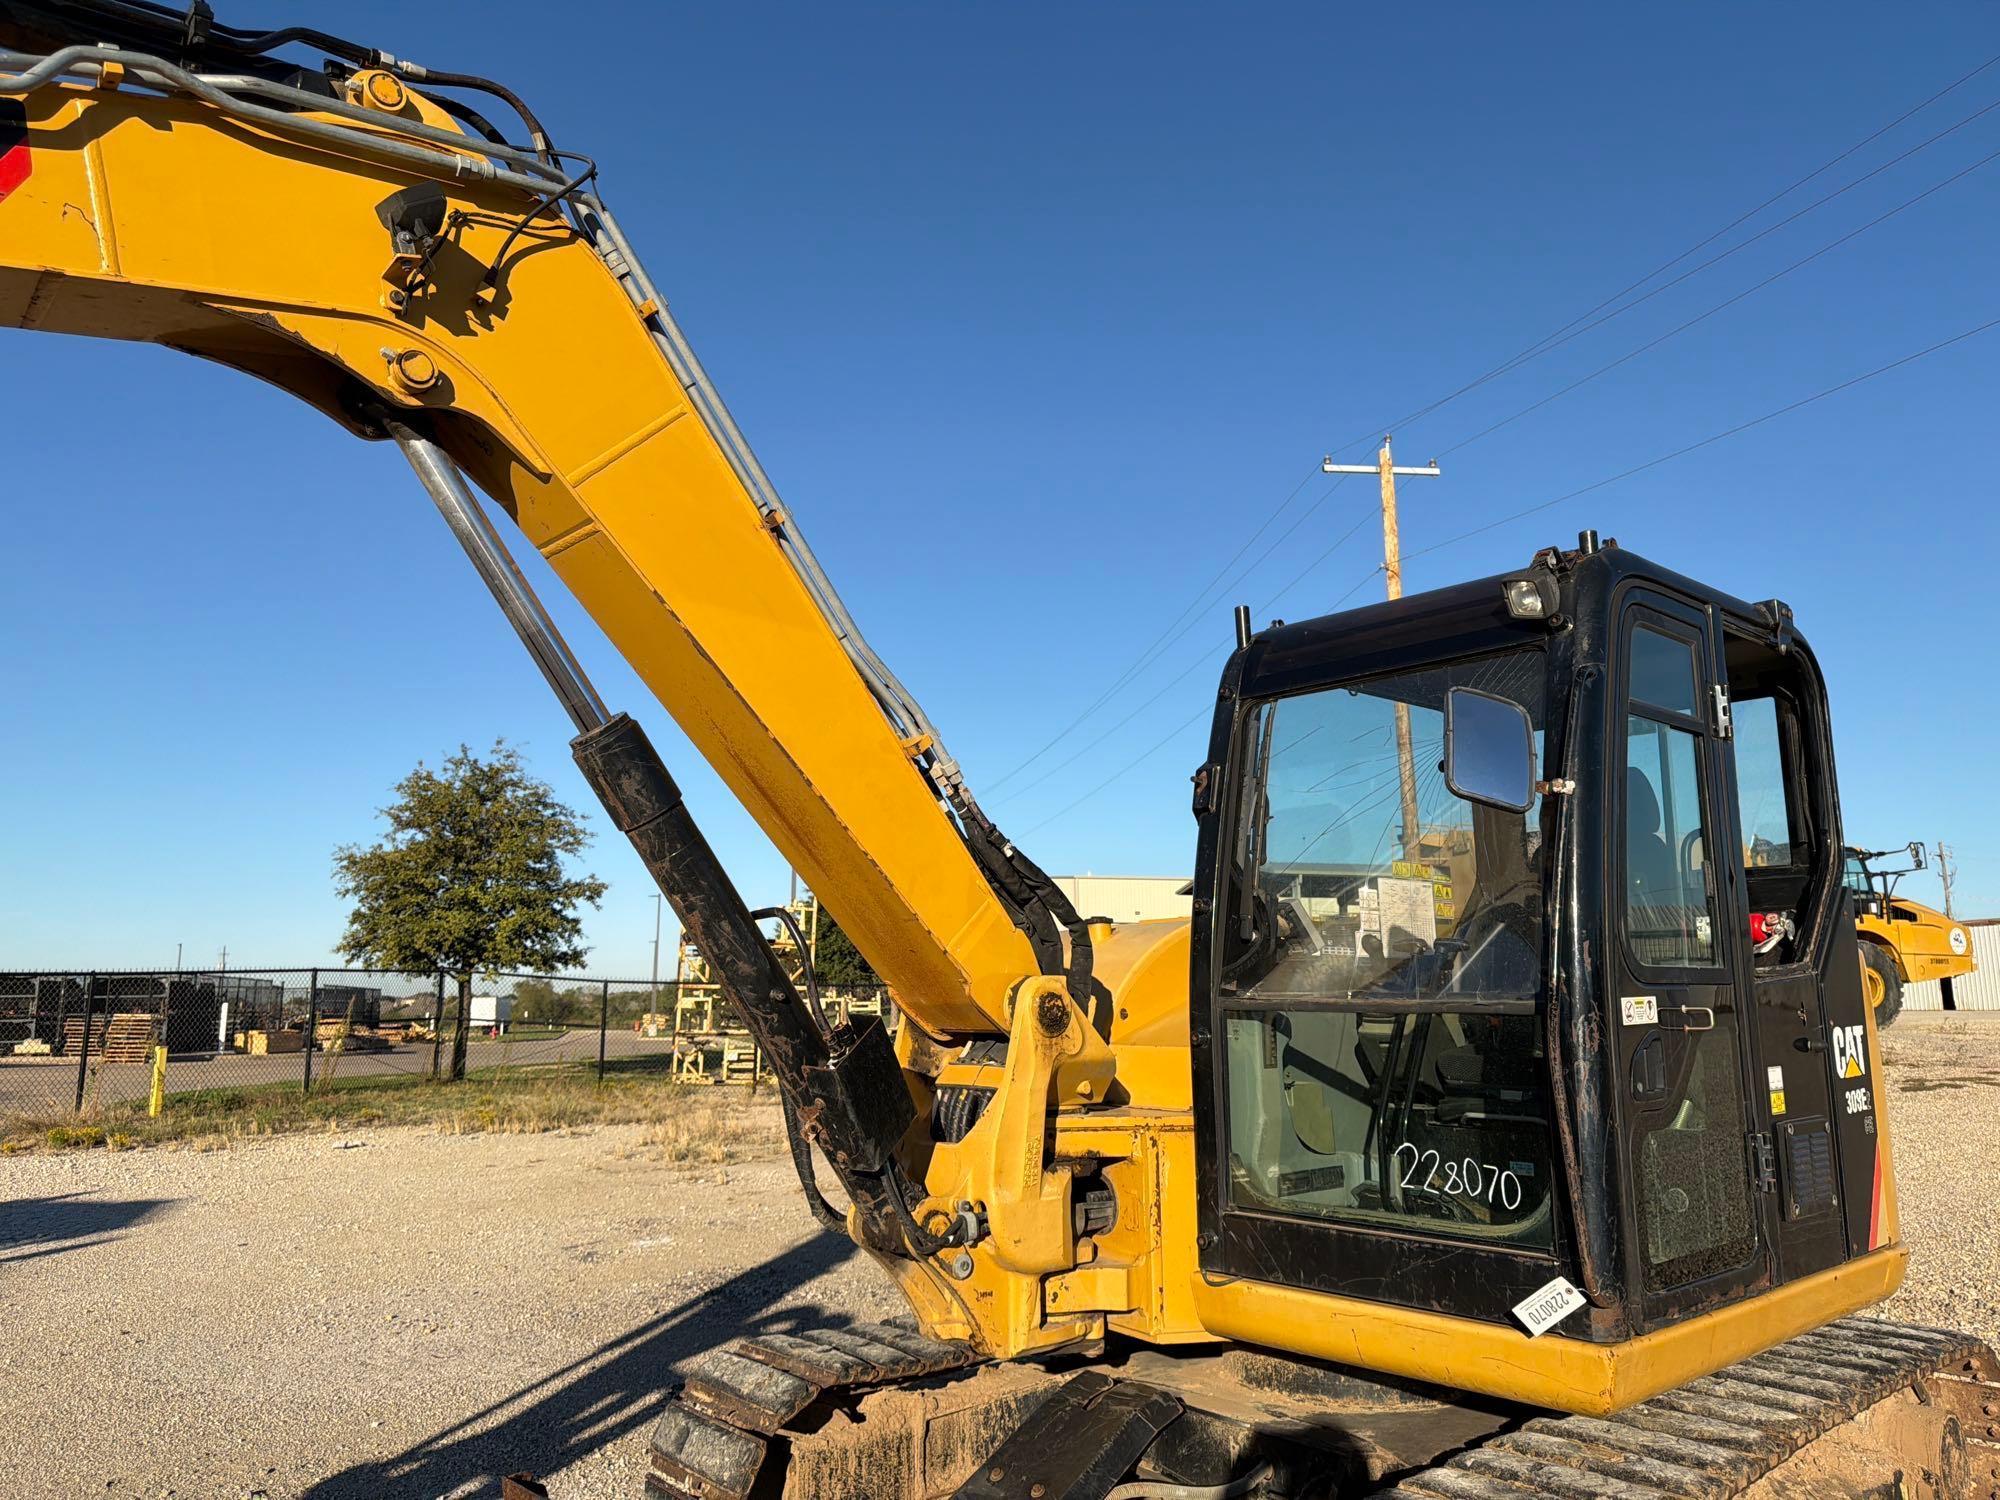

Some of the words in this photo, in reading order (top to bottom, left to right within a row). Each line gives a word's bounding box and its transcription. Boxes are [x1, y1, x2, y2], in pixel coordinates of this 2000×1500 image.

[1832, 1025, 1865, 1079] CAT
[1394, 1142, 1521, 1210] 228070
[1528, 1291, 1570, 1325] 228070
